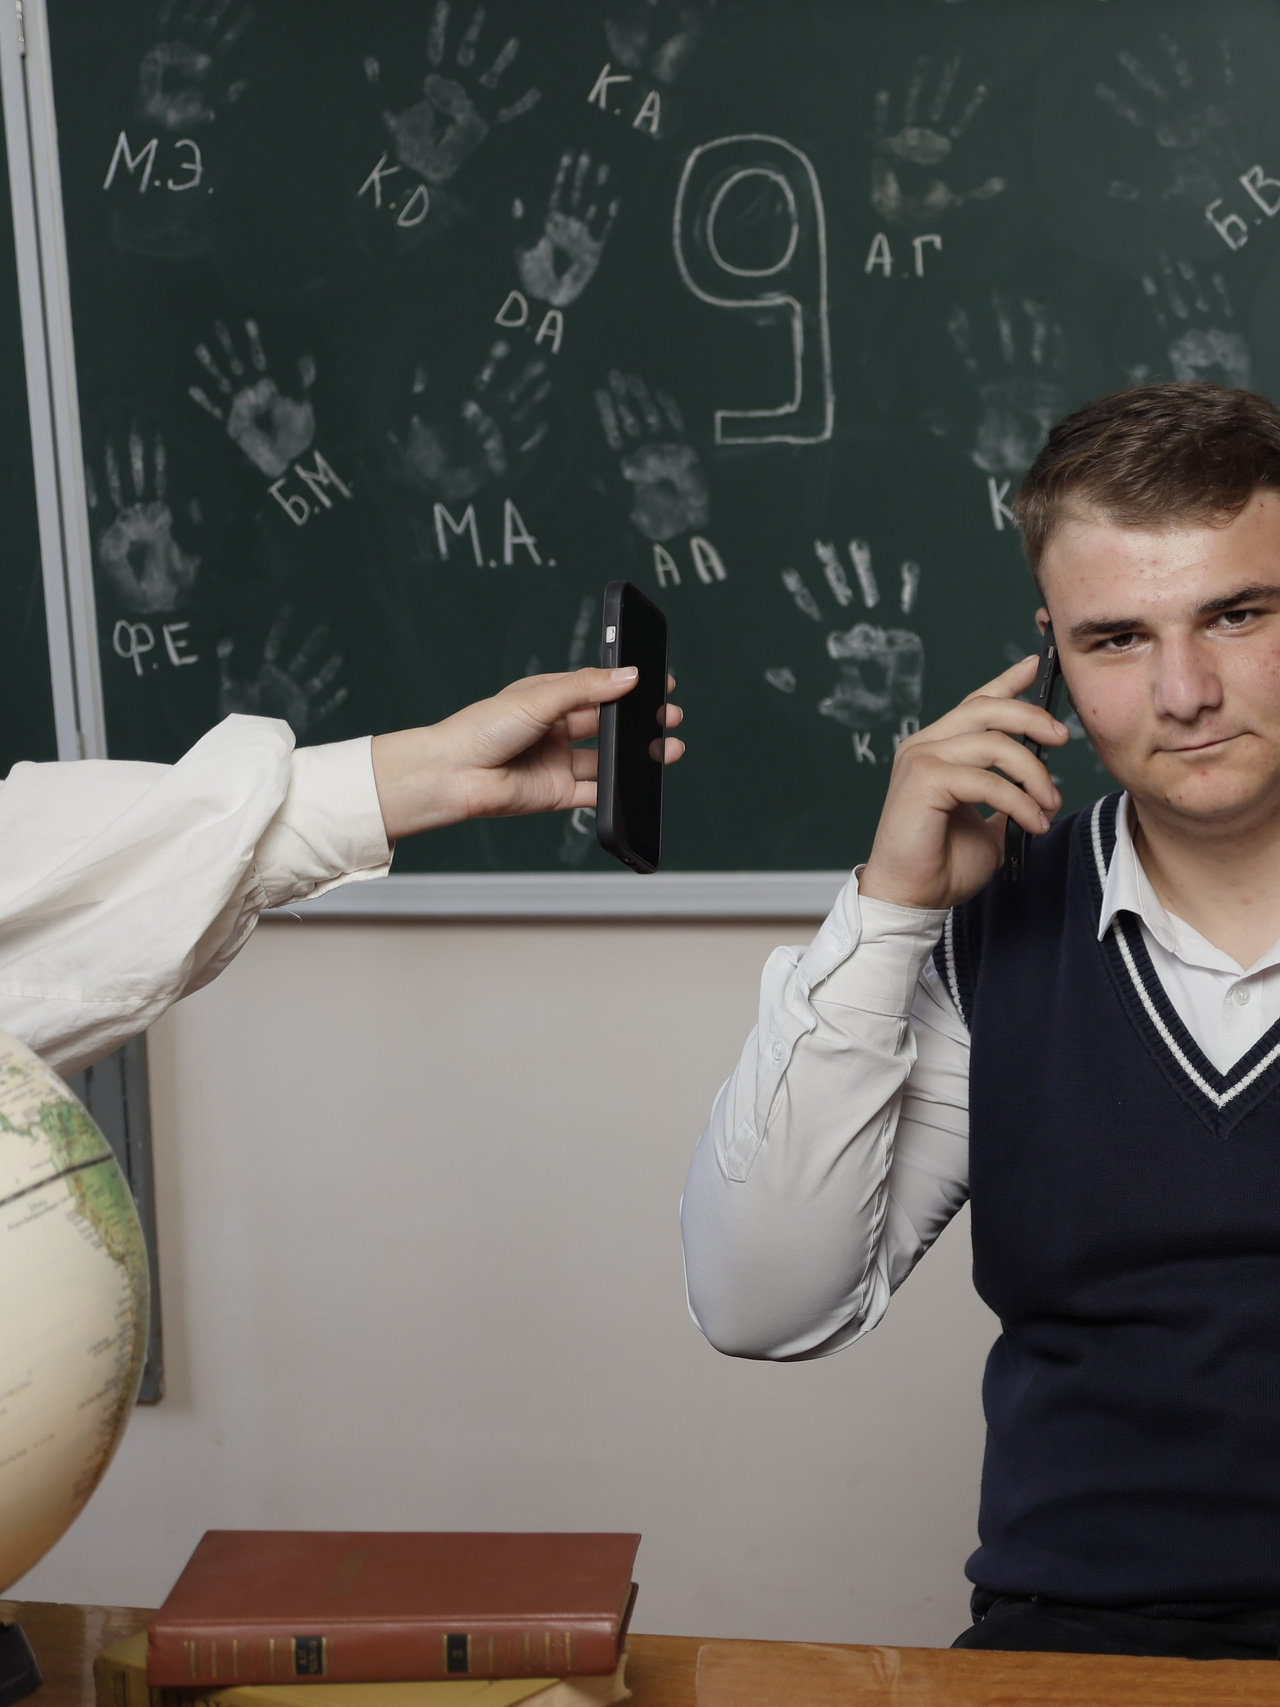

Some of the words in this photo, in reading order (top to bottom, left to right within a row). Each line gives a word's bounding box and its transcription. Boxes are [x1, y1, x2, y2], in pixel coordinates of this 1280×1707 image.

[103, 130, 214, 193] М.Э.
[673, 134, 834, 444] 9
[433, 498, 557, 567] М.А.
